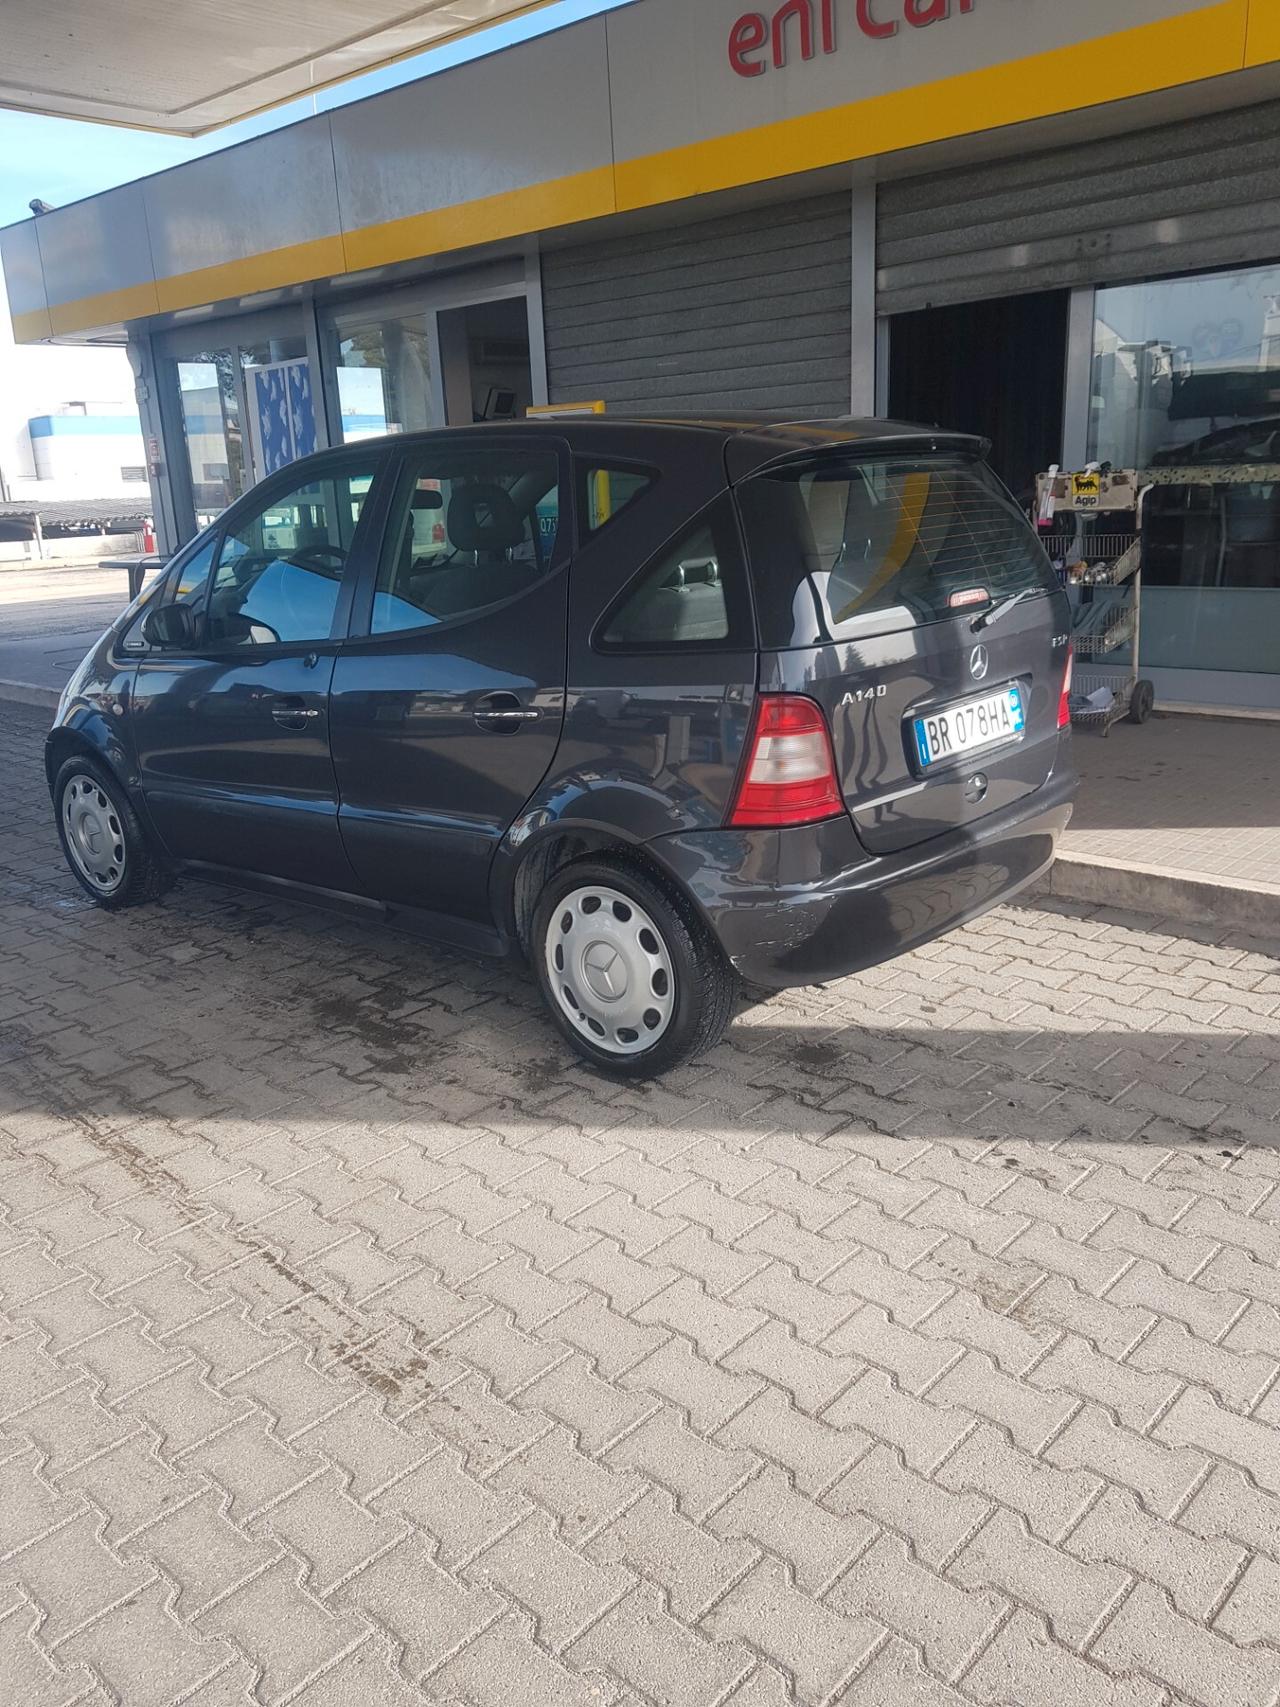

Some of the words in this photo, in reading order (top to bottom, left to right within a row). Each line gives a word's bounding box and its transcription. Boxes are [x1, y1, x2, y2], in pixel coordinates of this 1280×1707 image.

[1075, 496, 1097, 507] Agip
[841, 684, 887, 706] A140
[927, 717, 952, 755] BR
[955, 699, 1011, 744] 078HA
